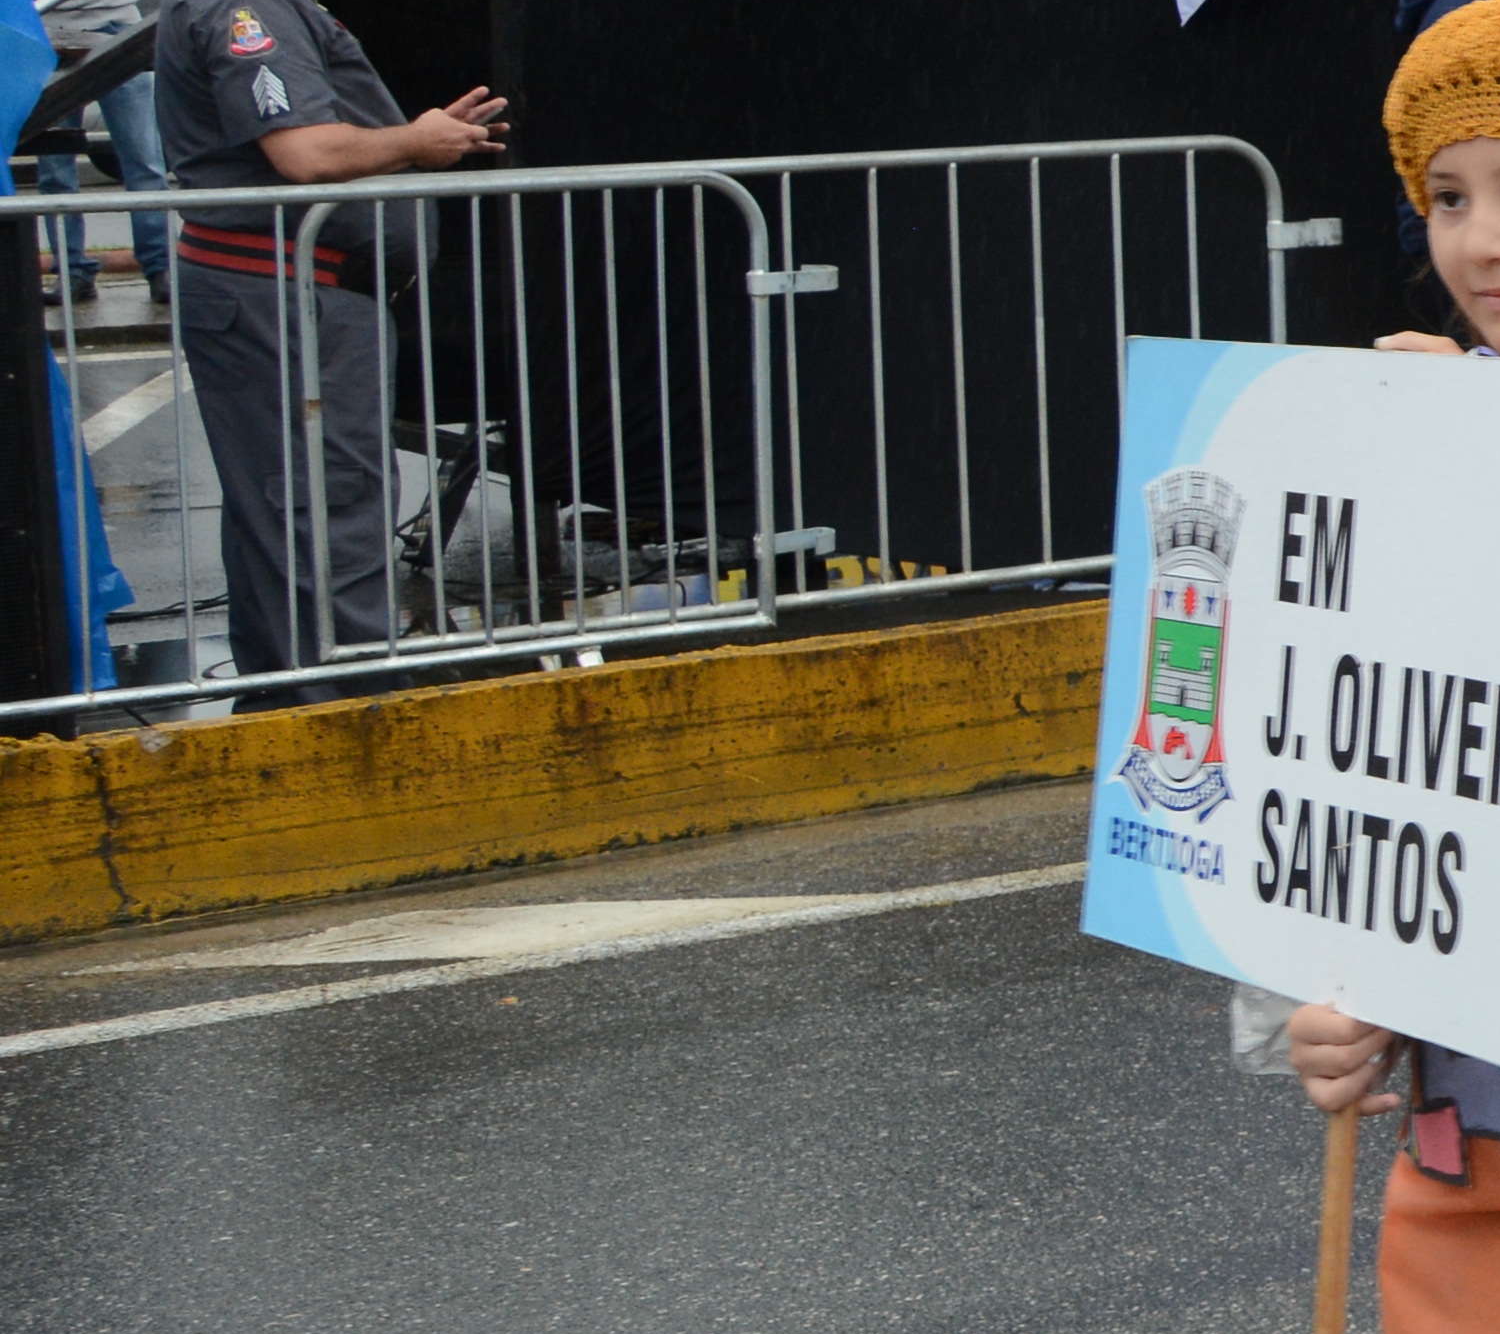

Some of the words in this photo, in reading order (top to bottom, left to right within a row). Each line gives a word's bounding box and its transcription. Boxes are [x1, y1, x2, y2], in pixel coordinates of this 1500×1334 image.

[1278, 490, 1358, 613] EM
[1262, 645, 1307, 761] J.
[1106, 817, 1226, 886] BERTIOGA
[1254, 788, 1465, 956] SANTOS
